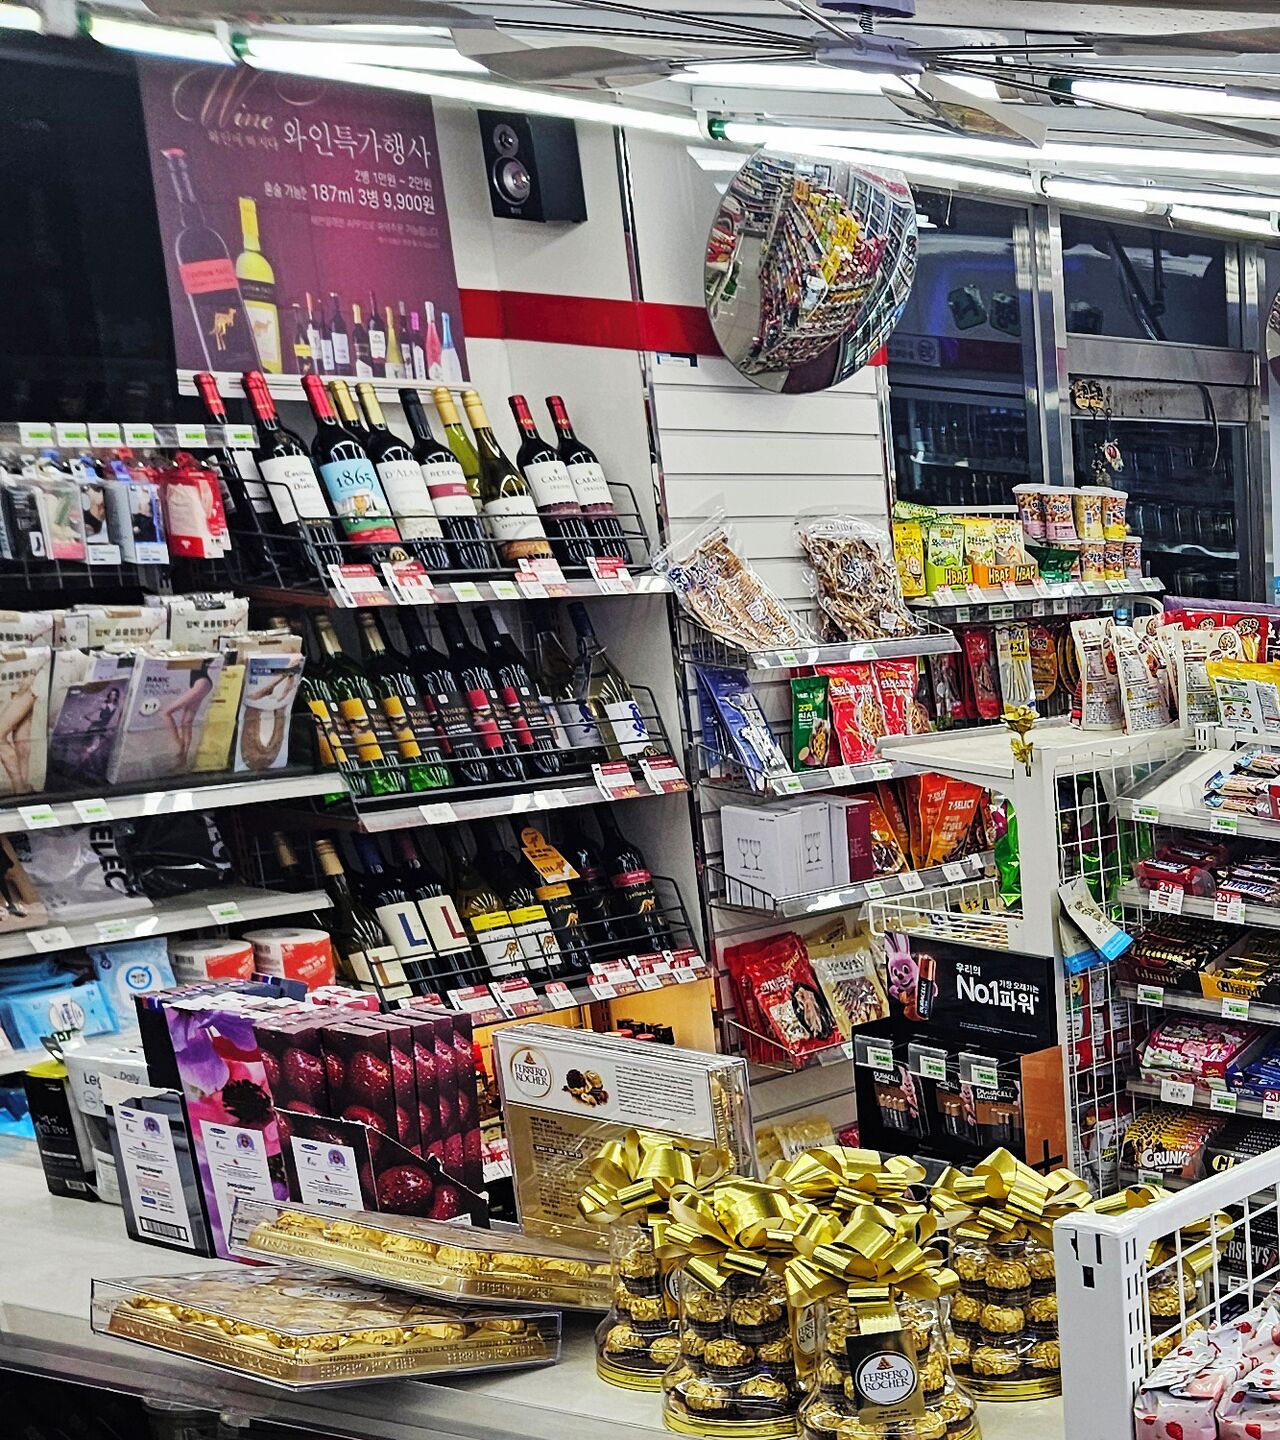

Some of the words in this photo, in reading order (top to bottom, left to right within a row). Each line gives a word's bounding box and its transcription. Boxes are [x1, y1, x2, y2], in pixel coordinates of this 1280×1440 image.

[283, 116, 432, 168] 와인특가행사
[311, 184, 354, 205] 187ml
[358, 189, 378, 209] 3병
[383, 192, 435, 215] 9,900원
[336, 465, 374, 489] 1865
[956, 962, 981, 977] 우리의
[957, 973, 999, 1005] No.1
[514, 1063, 548, 1078] FERRERO
[515, 1073, 549, 1088] ROCHER
